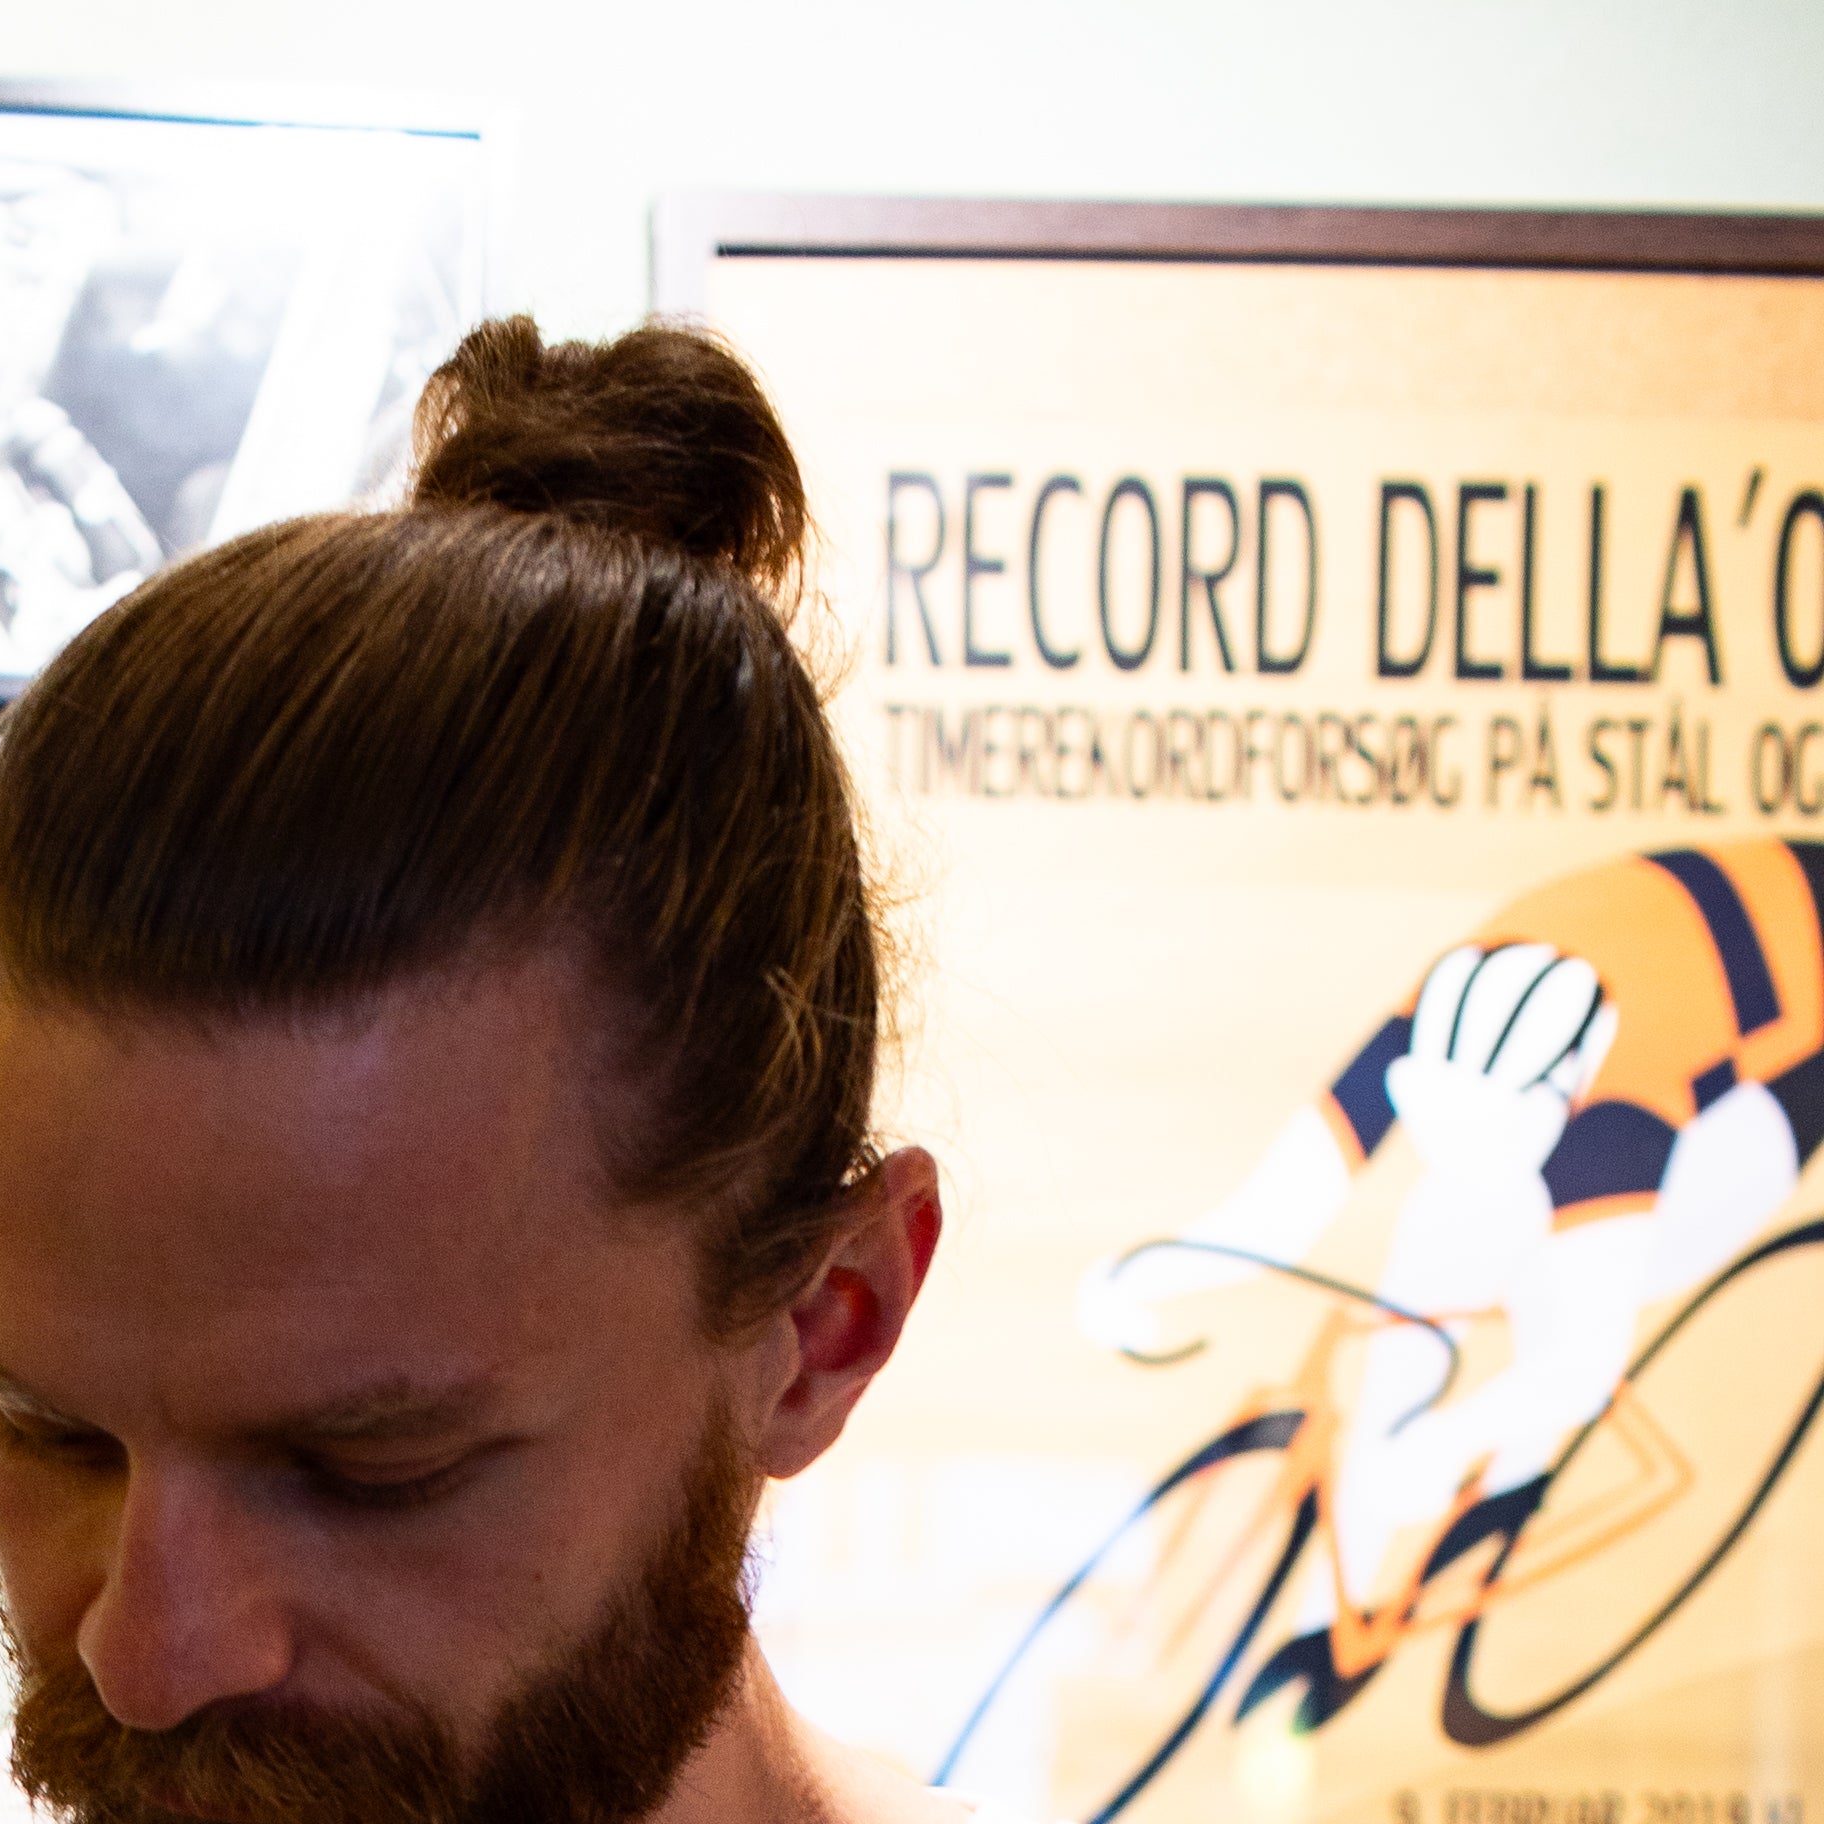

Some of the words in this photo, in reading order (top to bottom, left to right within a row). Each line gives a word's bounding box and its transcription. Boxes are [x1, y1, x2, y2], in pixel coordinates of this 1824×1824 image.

[885, 471, 1318, 675] RECORD
[884, 701, 1461, 806] TIMEREKORDFORSØG
[1486, 693, 1564, 808] PÅ
[1587, 693, 1728, 816] STÅL
